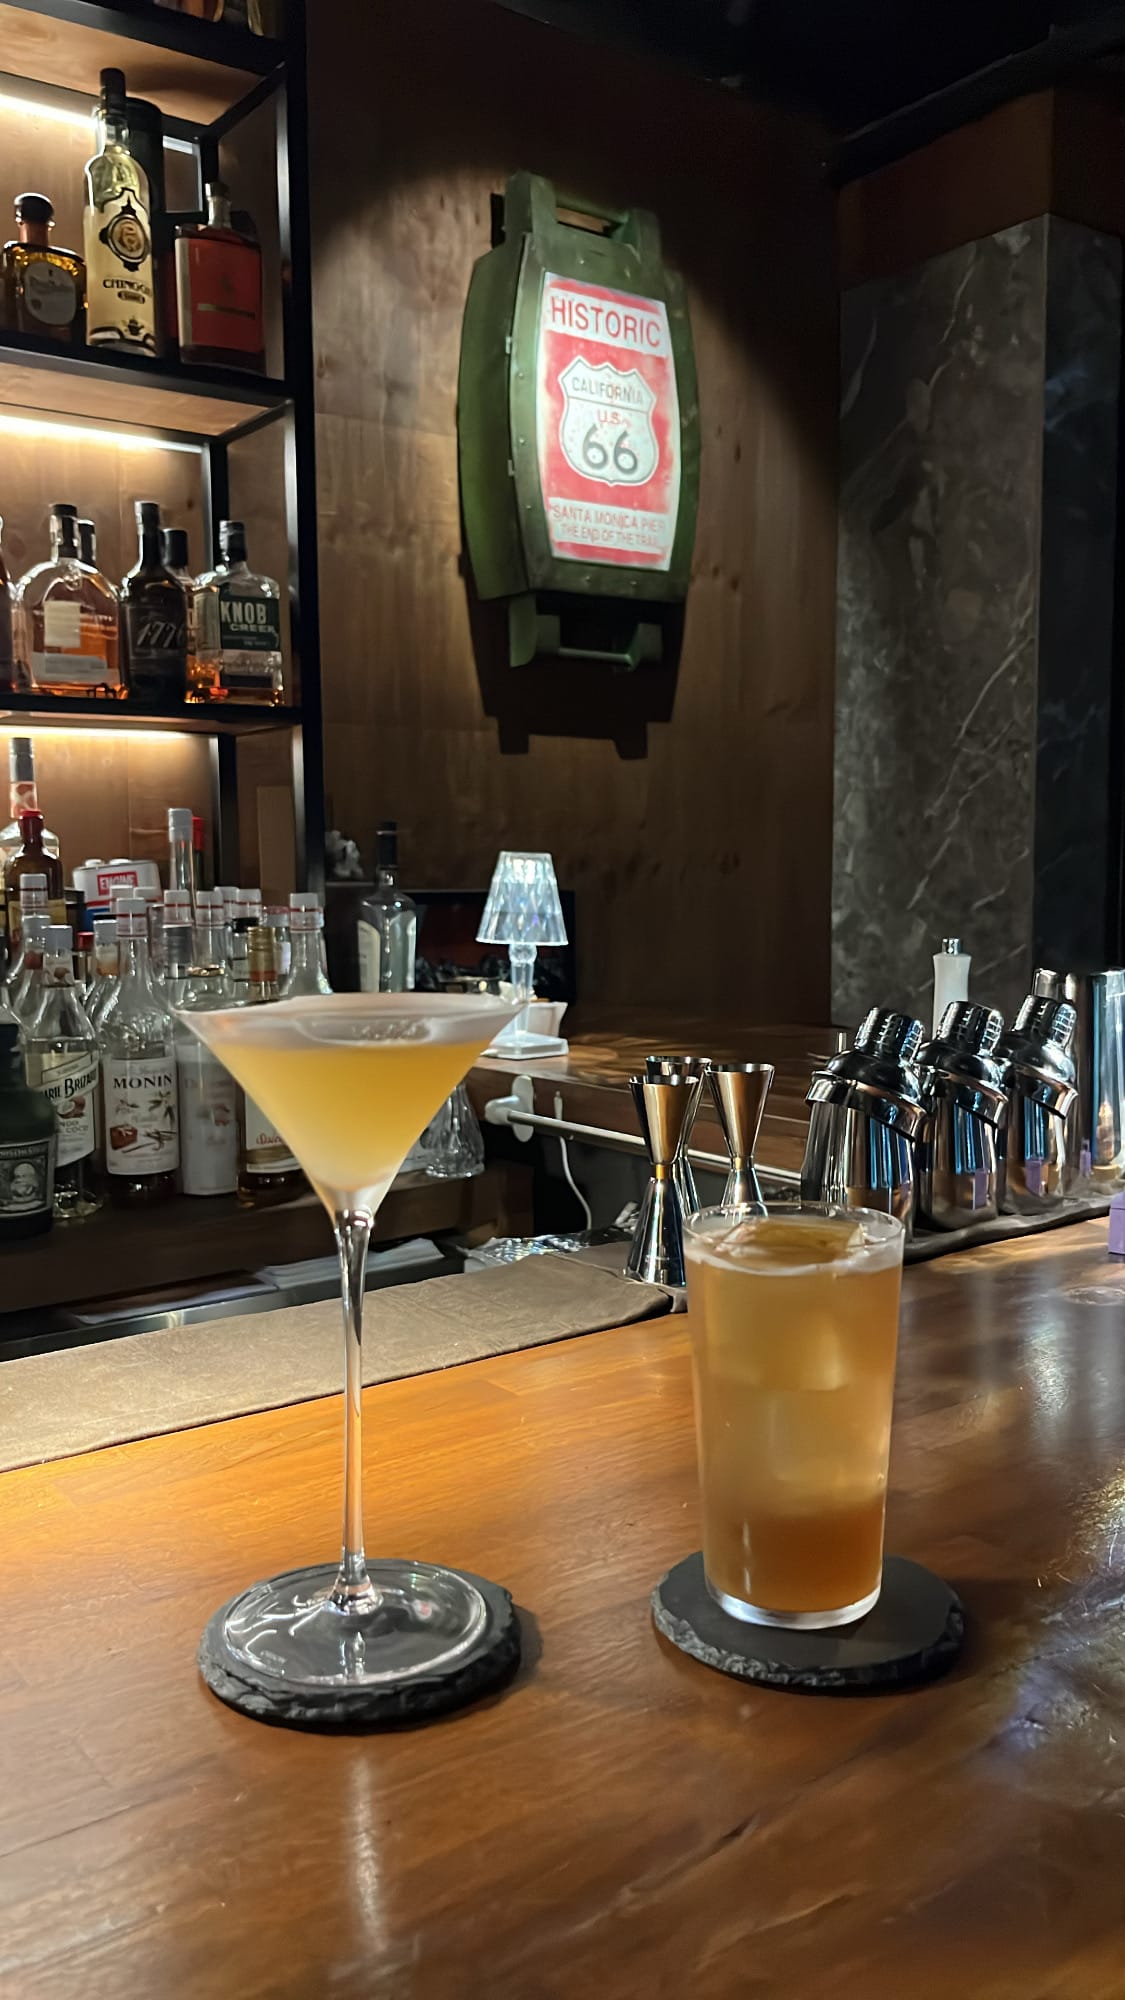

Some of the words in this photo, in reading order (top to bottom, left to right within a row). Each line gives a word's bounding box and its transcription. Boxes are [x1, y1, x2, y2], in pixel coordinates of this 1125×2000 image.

[550, 295, 661, 348] HISTORIC
[572, 377, 644, 405] CALIFORNIA
[582, 422, 639, 476] 66
[553, 504, 592, 523] SANTA
[595, 510, 639, 530] MONICA
[561, 523, 579, 536] THE
[580, 525, 600, 542] END
[601, 529, 615, 542] OF
[220, 601, 267, 625] KNOB
[230, 623, 276, 634] CREEK
[113, 1073, 172, 1089] MONIN
